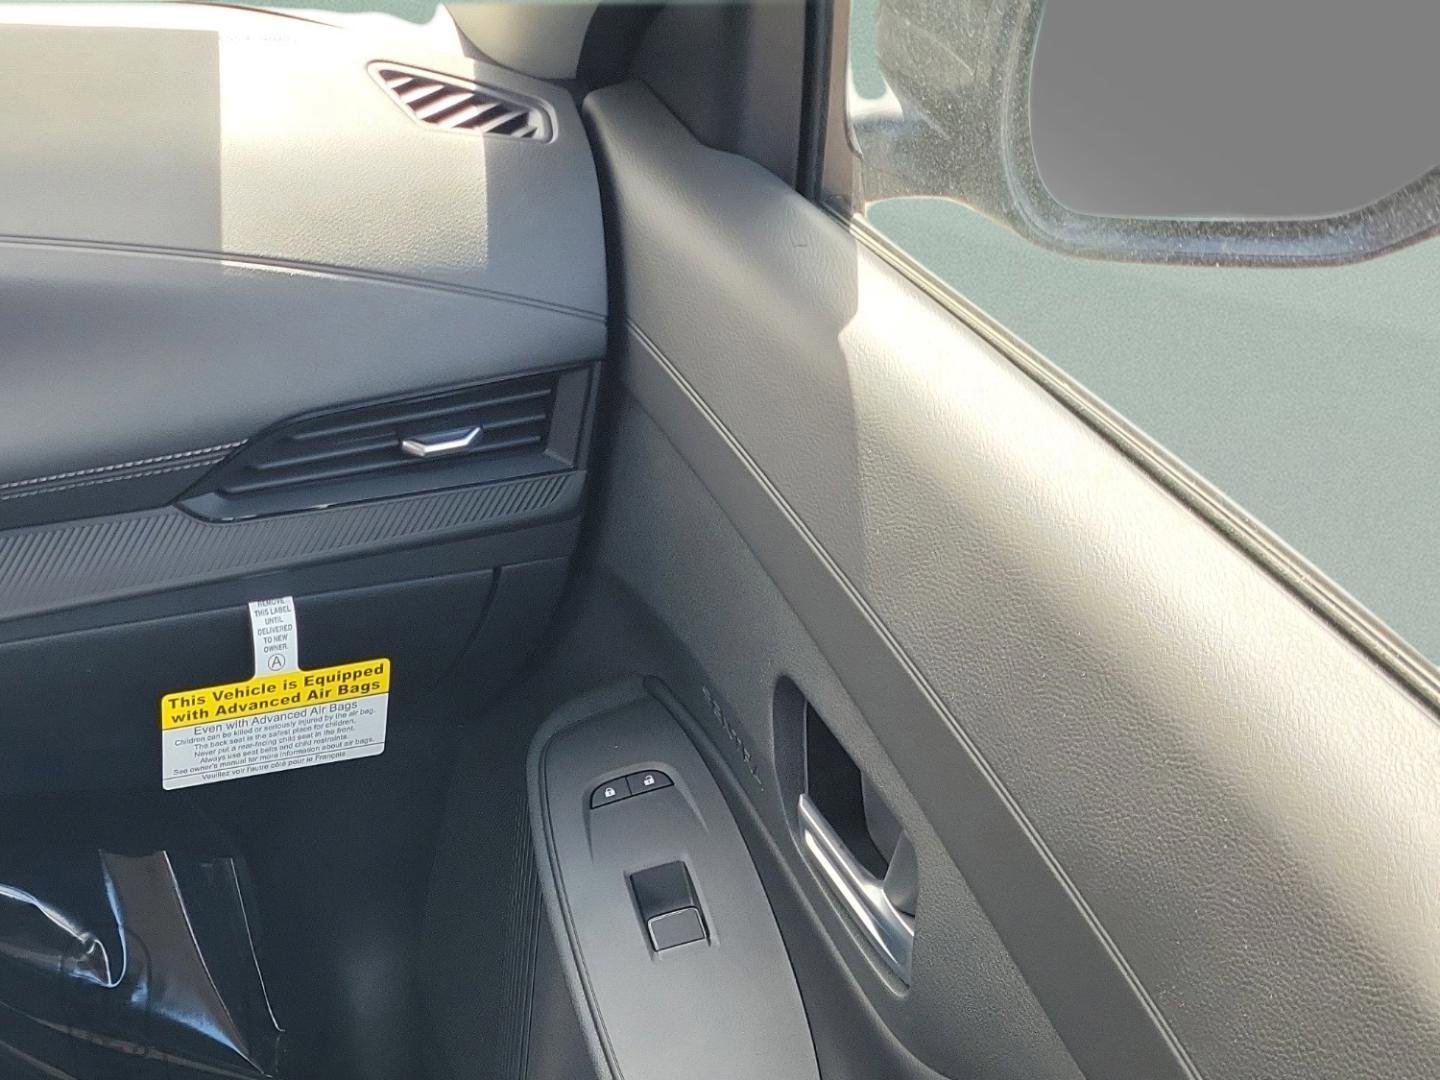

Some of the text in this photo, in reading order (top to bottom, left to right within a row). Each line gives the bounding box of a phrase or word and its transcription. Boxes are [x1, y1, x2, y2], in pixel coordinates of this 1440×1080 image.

[254, 605, 291, 617] THIS LABEL
[264, 617, 284, 625] UNTIL
[257, 624, 292, 636] DELIVERED
[274, 634, 288, 643] NEW
[271, 656, 282, 668] A
[168, 663, 384, 710] This Vehicle is Equipped
[171, 680, 381, 724] with Advanced Air Bags
[194, 702, 358, 735] Even with Advanced Air Bags
[175, 736, 206, 747] Children
[233, 727, 253, 736] killed
[298, 716, 323, 727] injured
[335, 711, 347, 719] the
[210, 739, 228, 748] back
[255, 732, 266, 740] the
